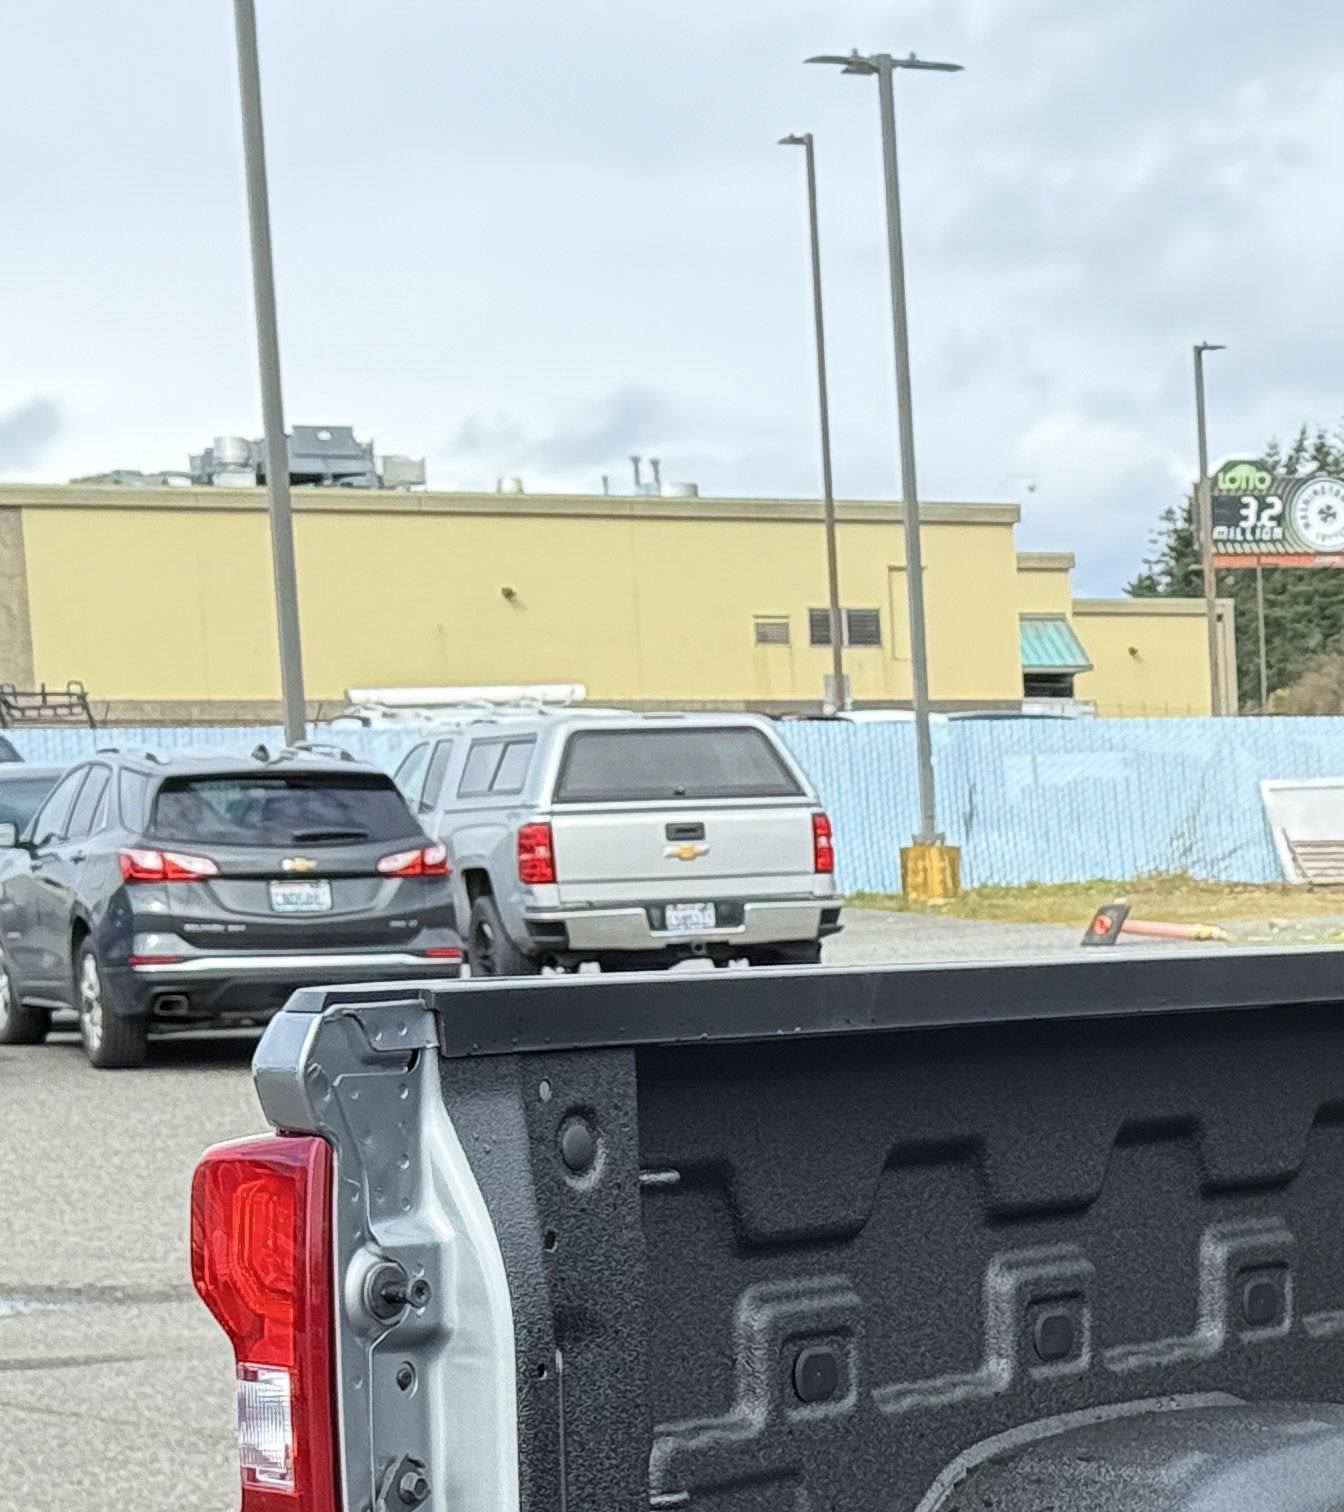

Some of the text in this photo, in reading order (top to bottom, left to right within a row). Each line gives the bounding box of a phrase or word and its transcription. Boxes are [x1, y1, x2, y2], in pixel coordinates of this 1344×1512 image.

[1218, 464, 1272, 490] LOTTO
[1238, 496, 1283, 528] 32
[1213, 526, 1283, 541] MILLION
